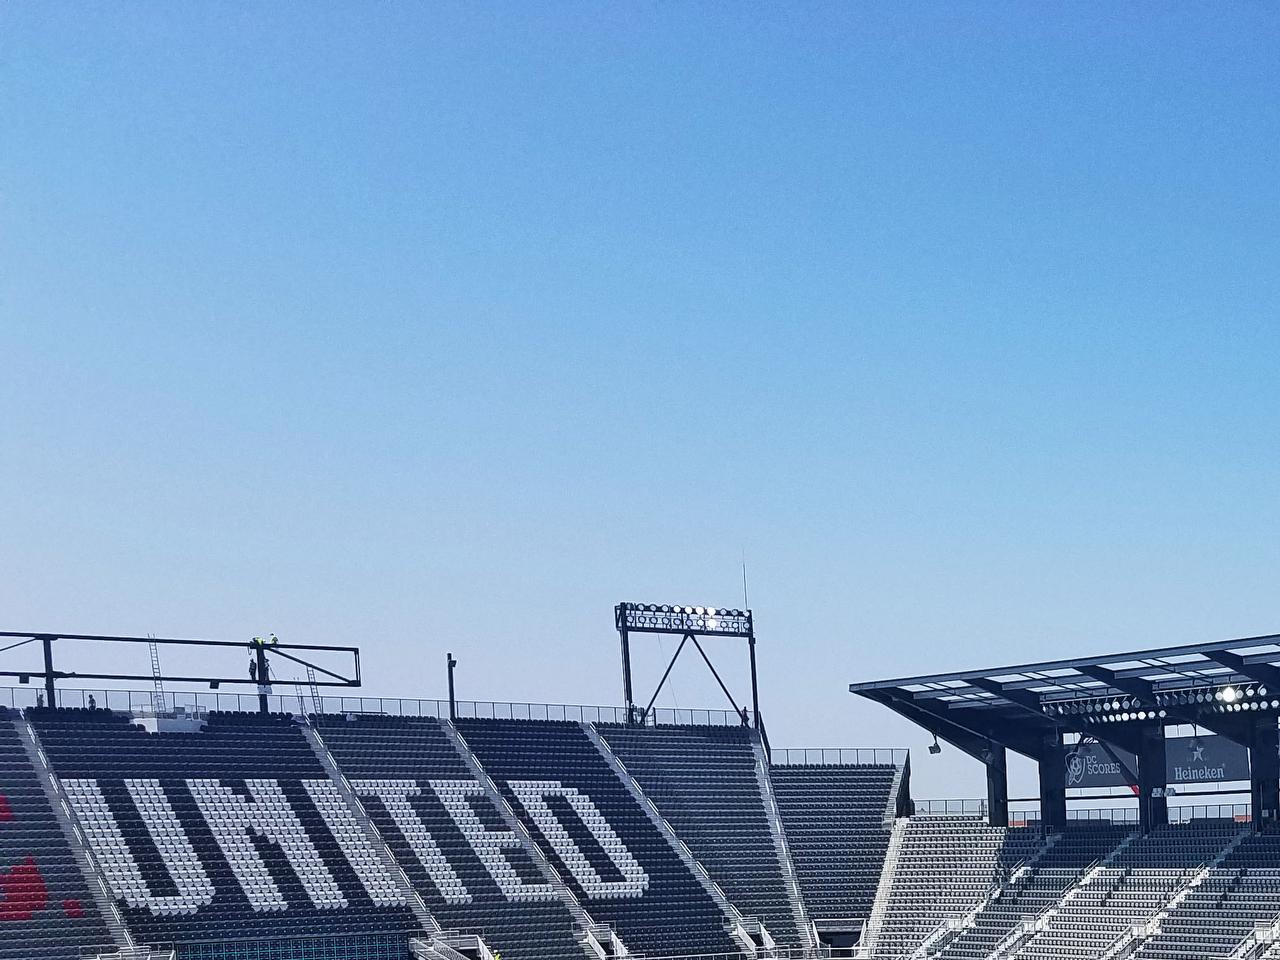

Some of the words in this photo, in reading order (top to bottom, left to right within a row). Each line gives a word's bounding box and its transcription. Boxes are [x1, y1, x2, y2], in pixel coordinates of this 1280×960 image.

[1086, 755, 1097, 764] DC
[1087, 763, 1121, 775] SCORES
[1174, 766, 1224, 780] Heineken
[60, 778, 649, 915] UNITED
